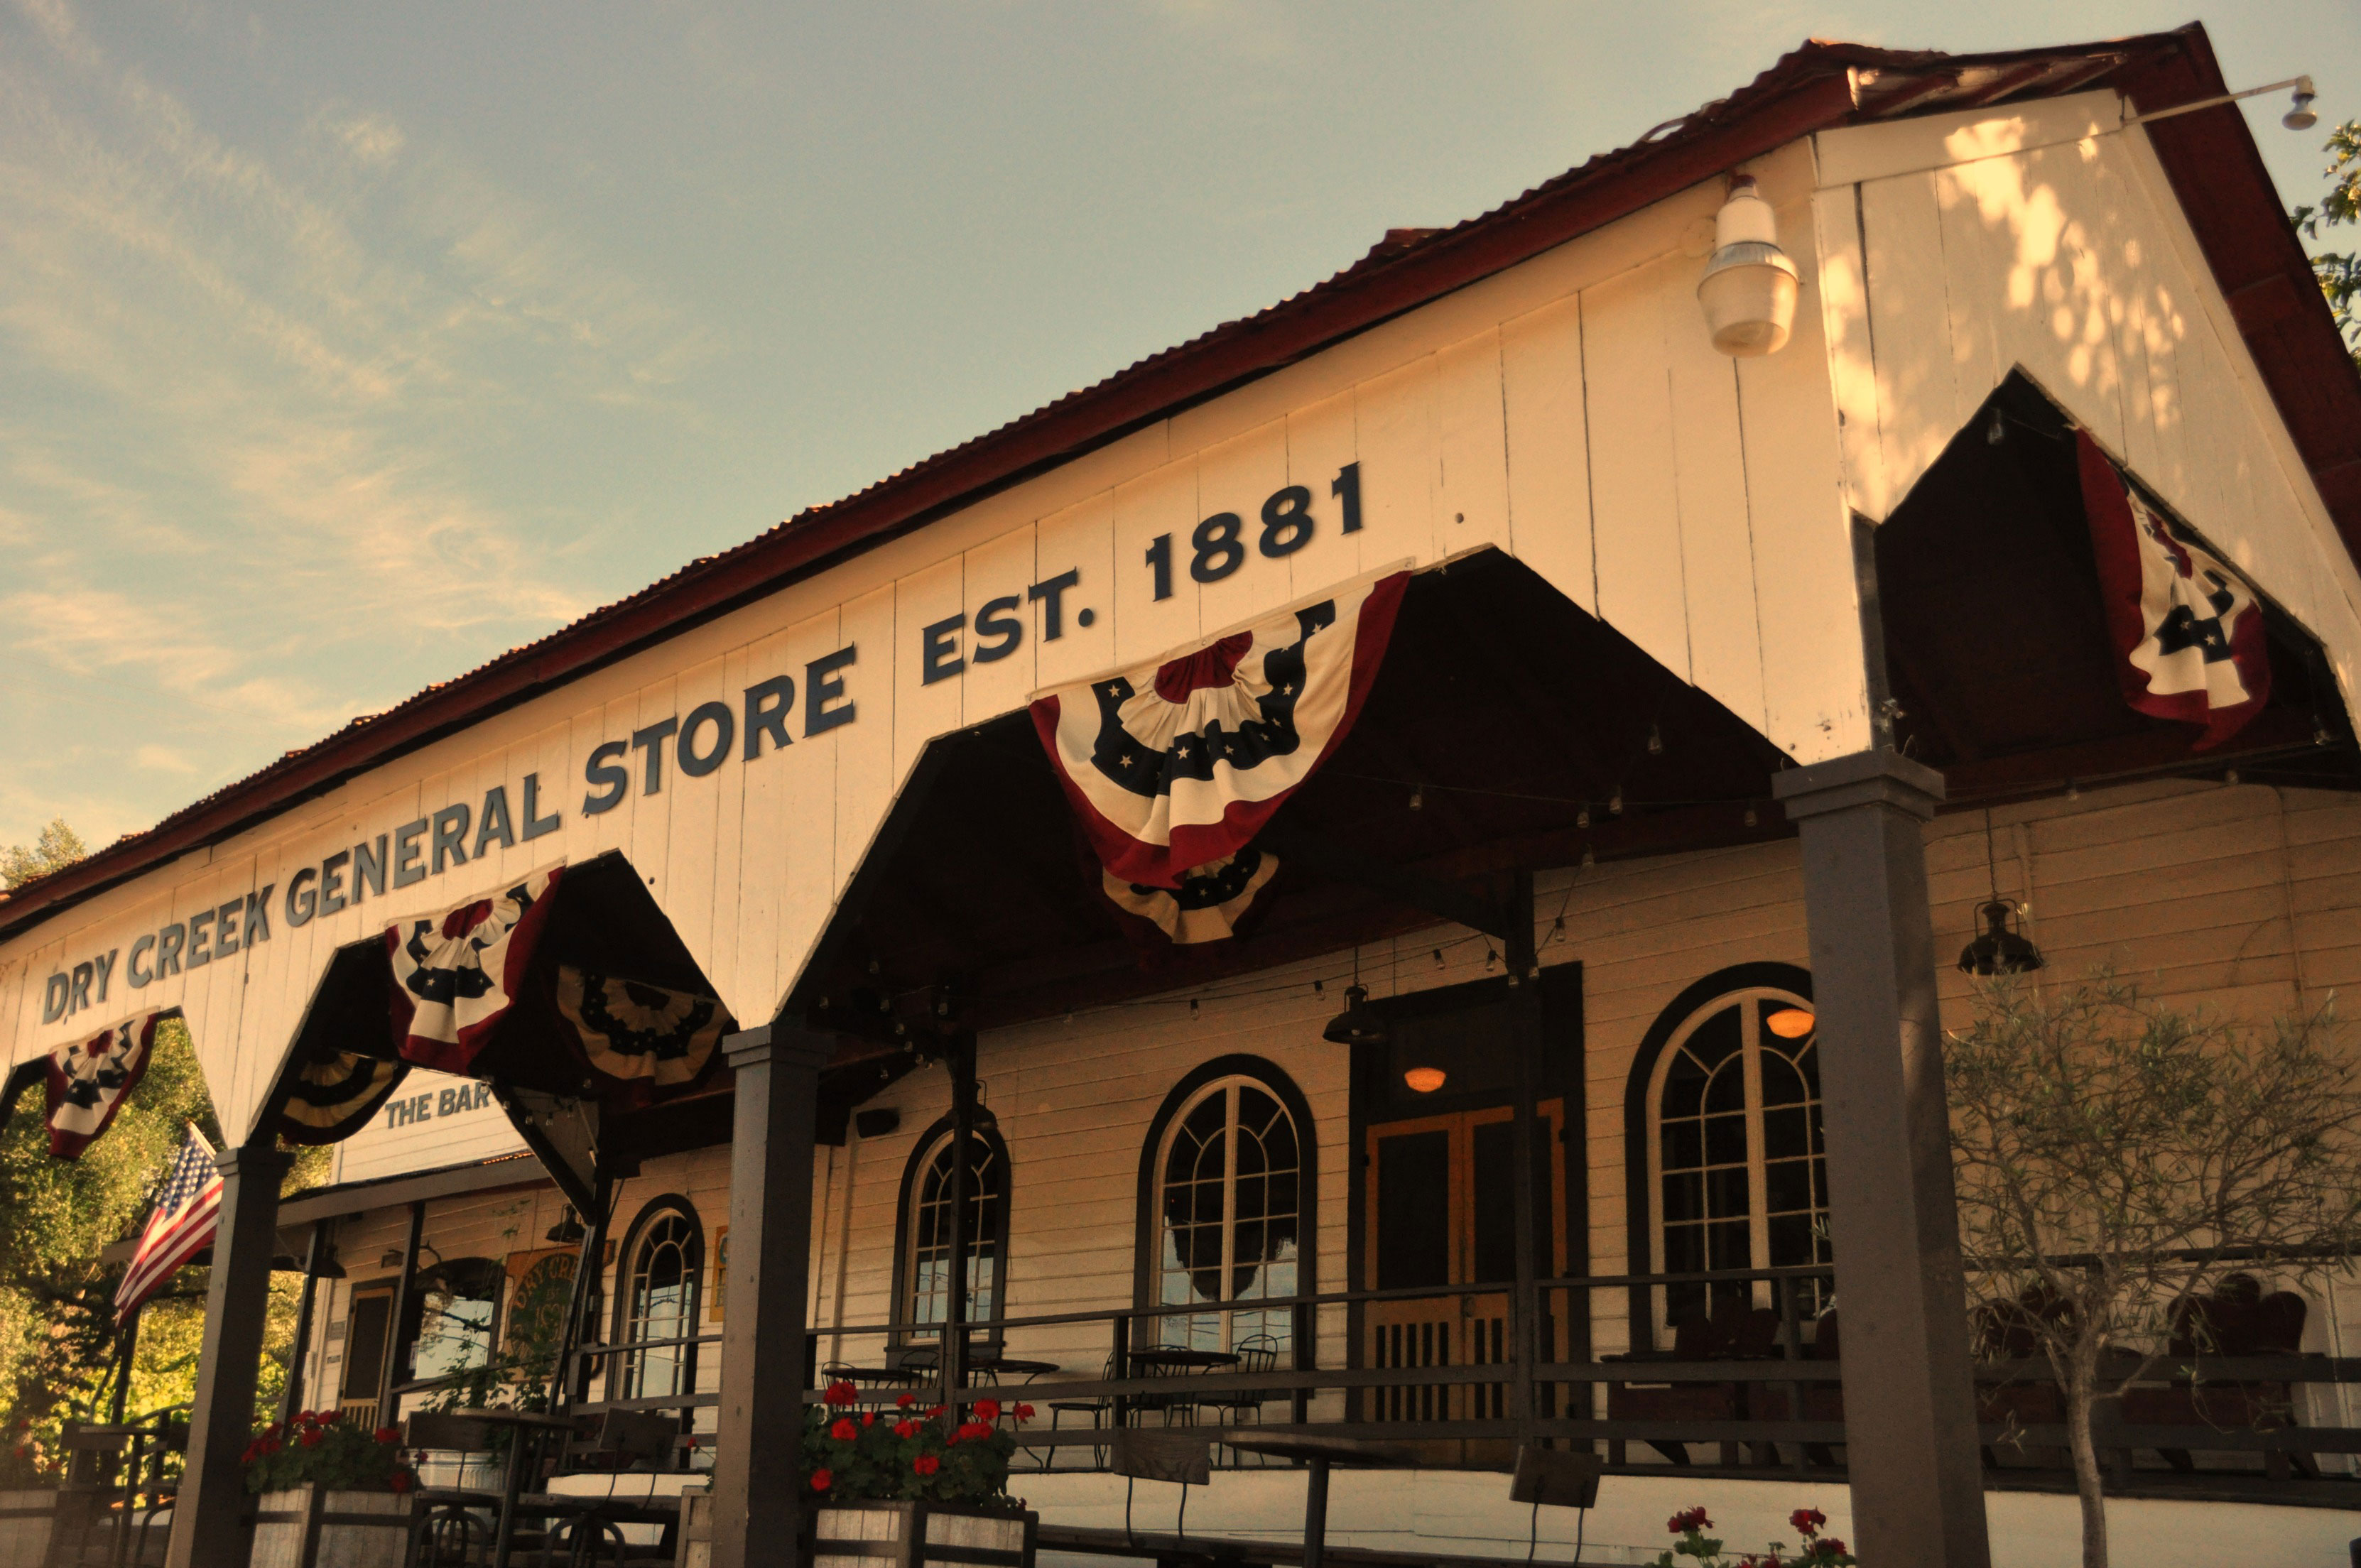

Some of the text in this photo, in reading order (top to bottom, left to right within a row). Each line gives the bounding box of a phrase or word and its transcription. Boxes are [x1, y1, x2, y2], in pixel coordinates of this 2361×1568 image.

[42, 461, 1364, 1025] DRY CREEK GENERAL STORE EST. 1881
[384, 1082, 491, 1129] THE BAR
[514, 1261, 543, 1309] DRY
